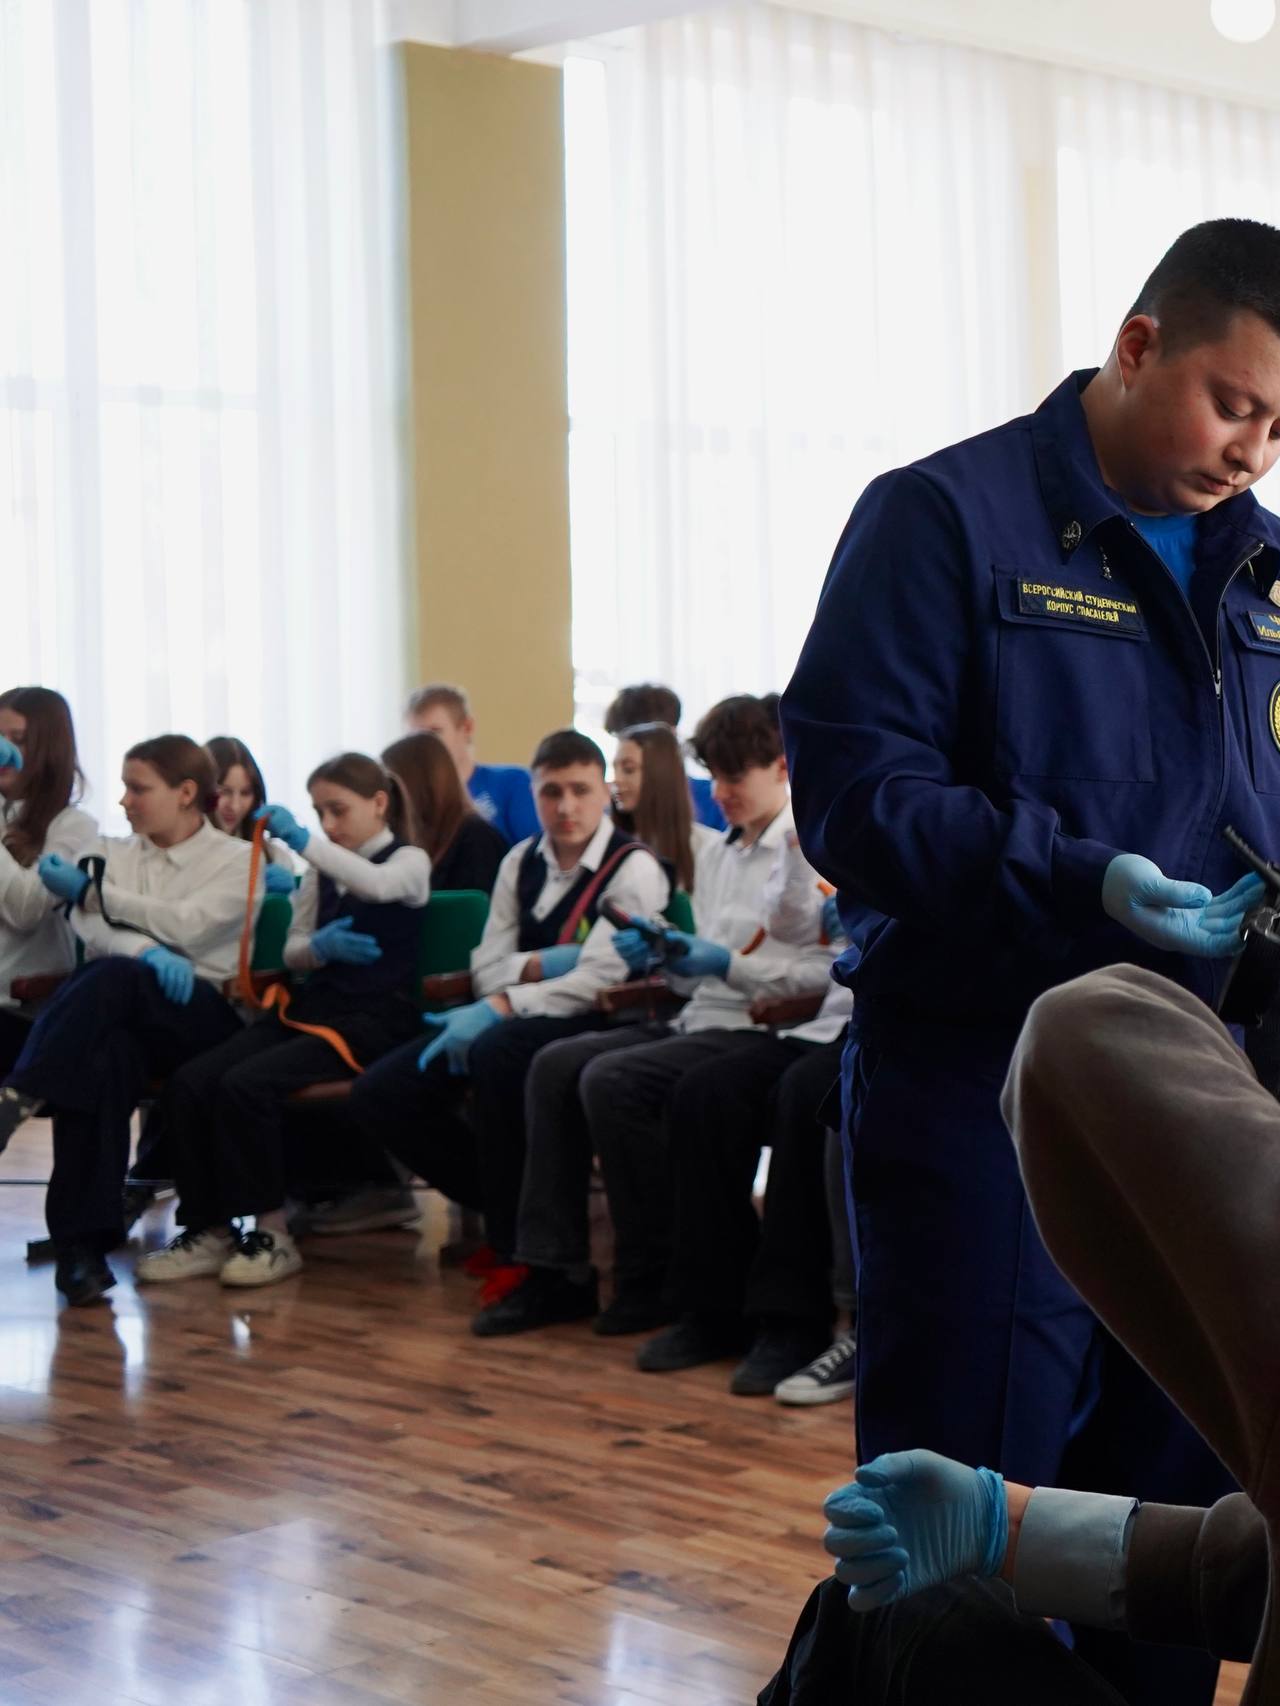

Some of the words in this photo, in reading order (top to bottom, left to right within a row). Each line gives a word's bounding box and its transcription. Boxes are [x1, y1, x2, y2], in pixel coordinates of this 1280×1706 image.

[1022, 583, 1083, 602] ВСЕРОССИЙСКИЙ
[1085, 594, 1137, 613] СТУДЕНЧЕСКИЙ
[1046, 600, 1074, 614] КОРПУС
[1076, 605, 1120, 622] СПАСАТЕЛЕЙ
